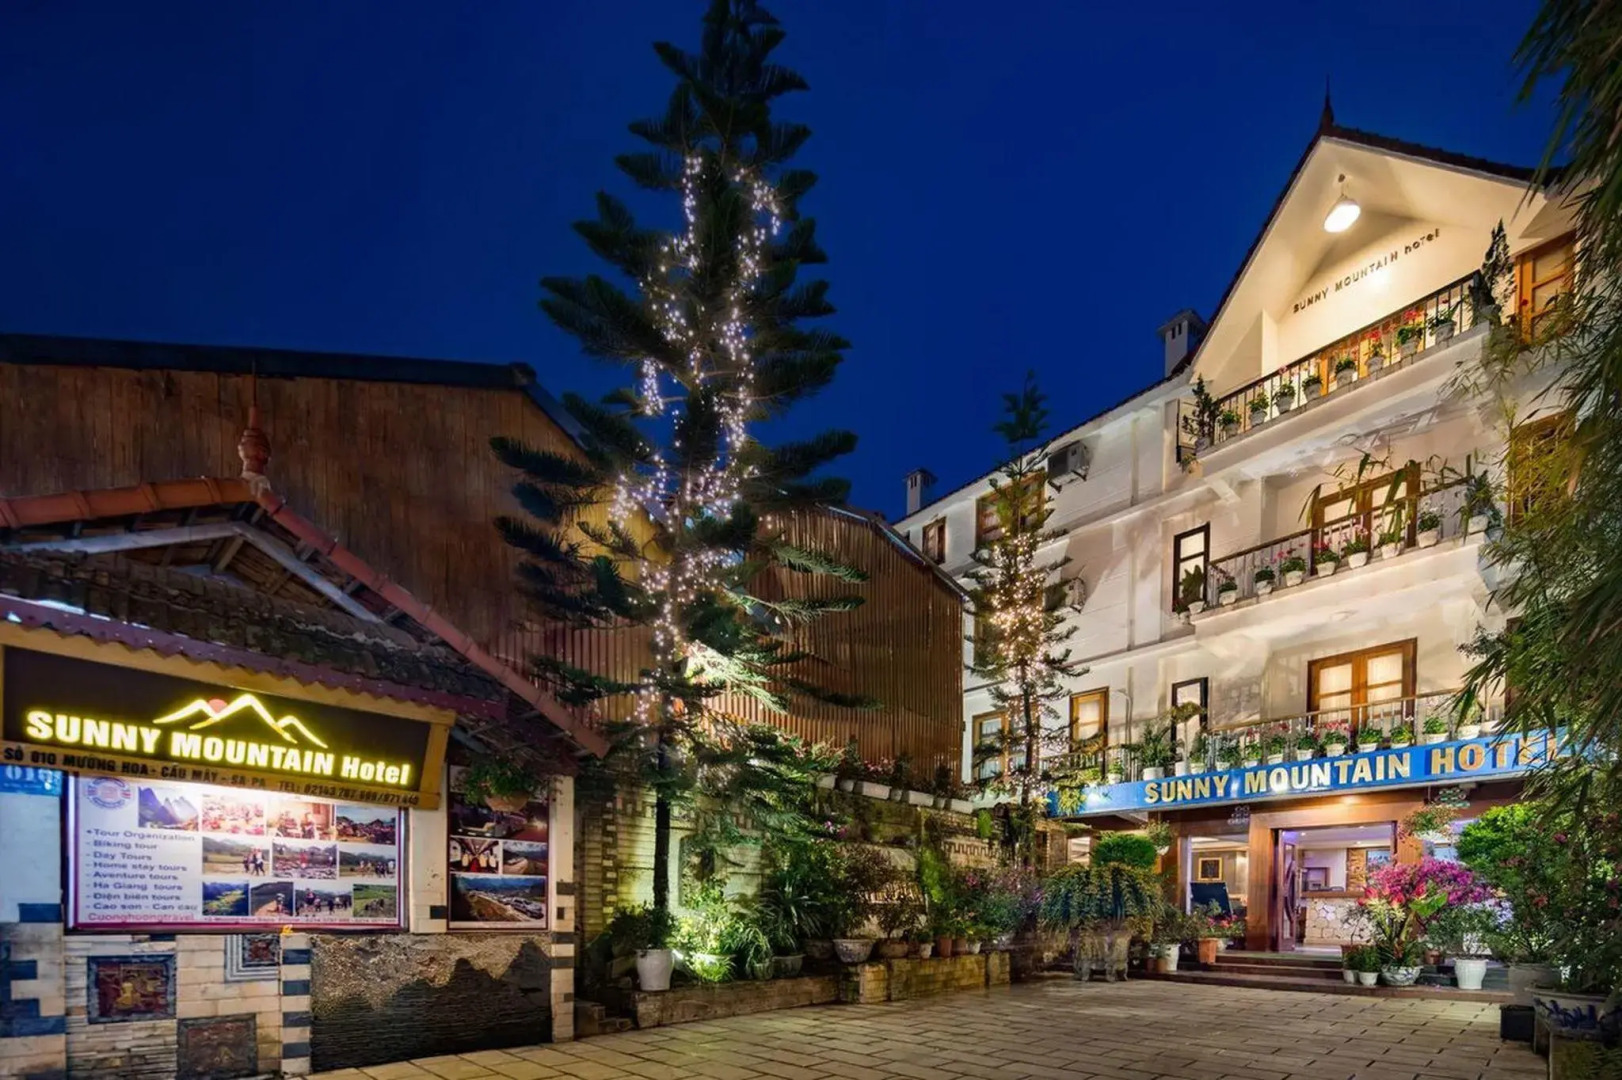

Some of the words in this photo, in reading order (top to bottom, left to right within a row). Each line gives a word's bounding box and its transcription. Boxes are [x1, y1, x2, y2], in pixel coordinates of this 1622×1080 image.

[1293, 287, 1329, 314] SUNNY
[1335, 251, 1398, 292] MOUNTAIN
[25, 710, 162, 754] SUNNY
[170, 731, 336, 776] MOUNTAIN
[340, 755, 410, 785] Hotel
[1143, 775, 1230, 804] SUNNY
[1244, 752, 1411, 795] MOUNTAIN
[93, 828, 120, 837] Tour
[123, 830, 196, 842] Organization
[93, 840, 132, 850] Biking
[93, 851, 116, 861] Day
[120, 852, 153, 861] Tours
[132, 863, 156, 872] stay
[159, 864, 188, 872] tours
[93, 871, 146, 880] Aventure
[113, 882, 148, 891] Giang
[153, 883, 183, 891] tours
[93, 902, 118, 910] Cao
